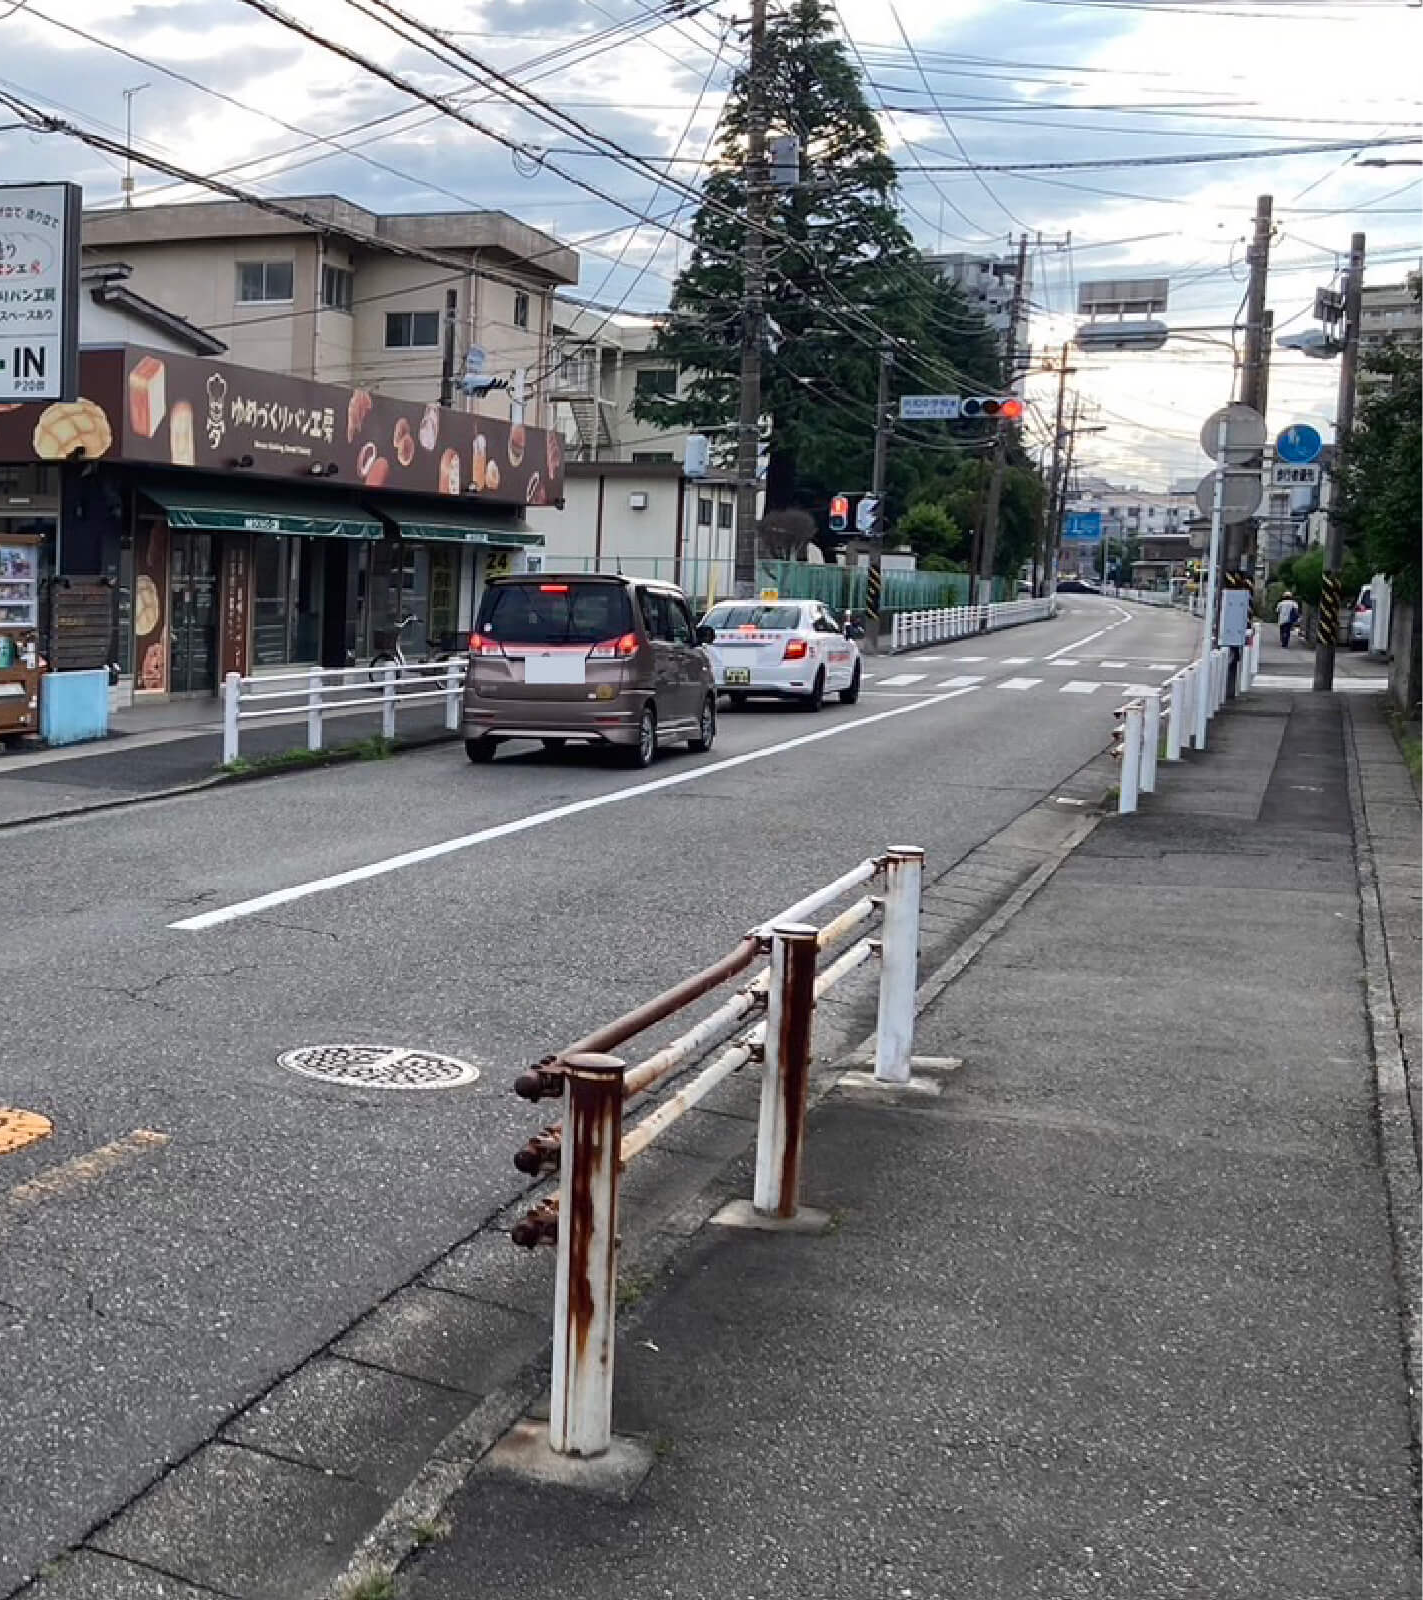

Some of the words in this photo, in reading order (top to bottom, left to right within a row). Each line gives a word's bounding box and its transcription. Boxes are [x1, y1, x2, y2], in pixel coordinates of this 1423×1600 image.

[13, 345, 46, 378] IN
[231, 395, 335, 444] ゆめづくりパン工房
